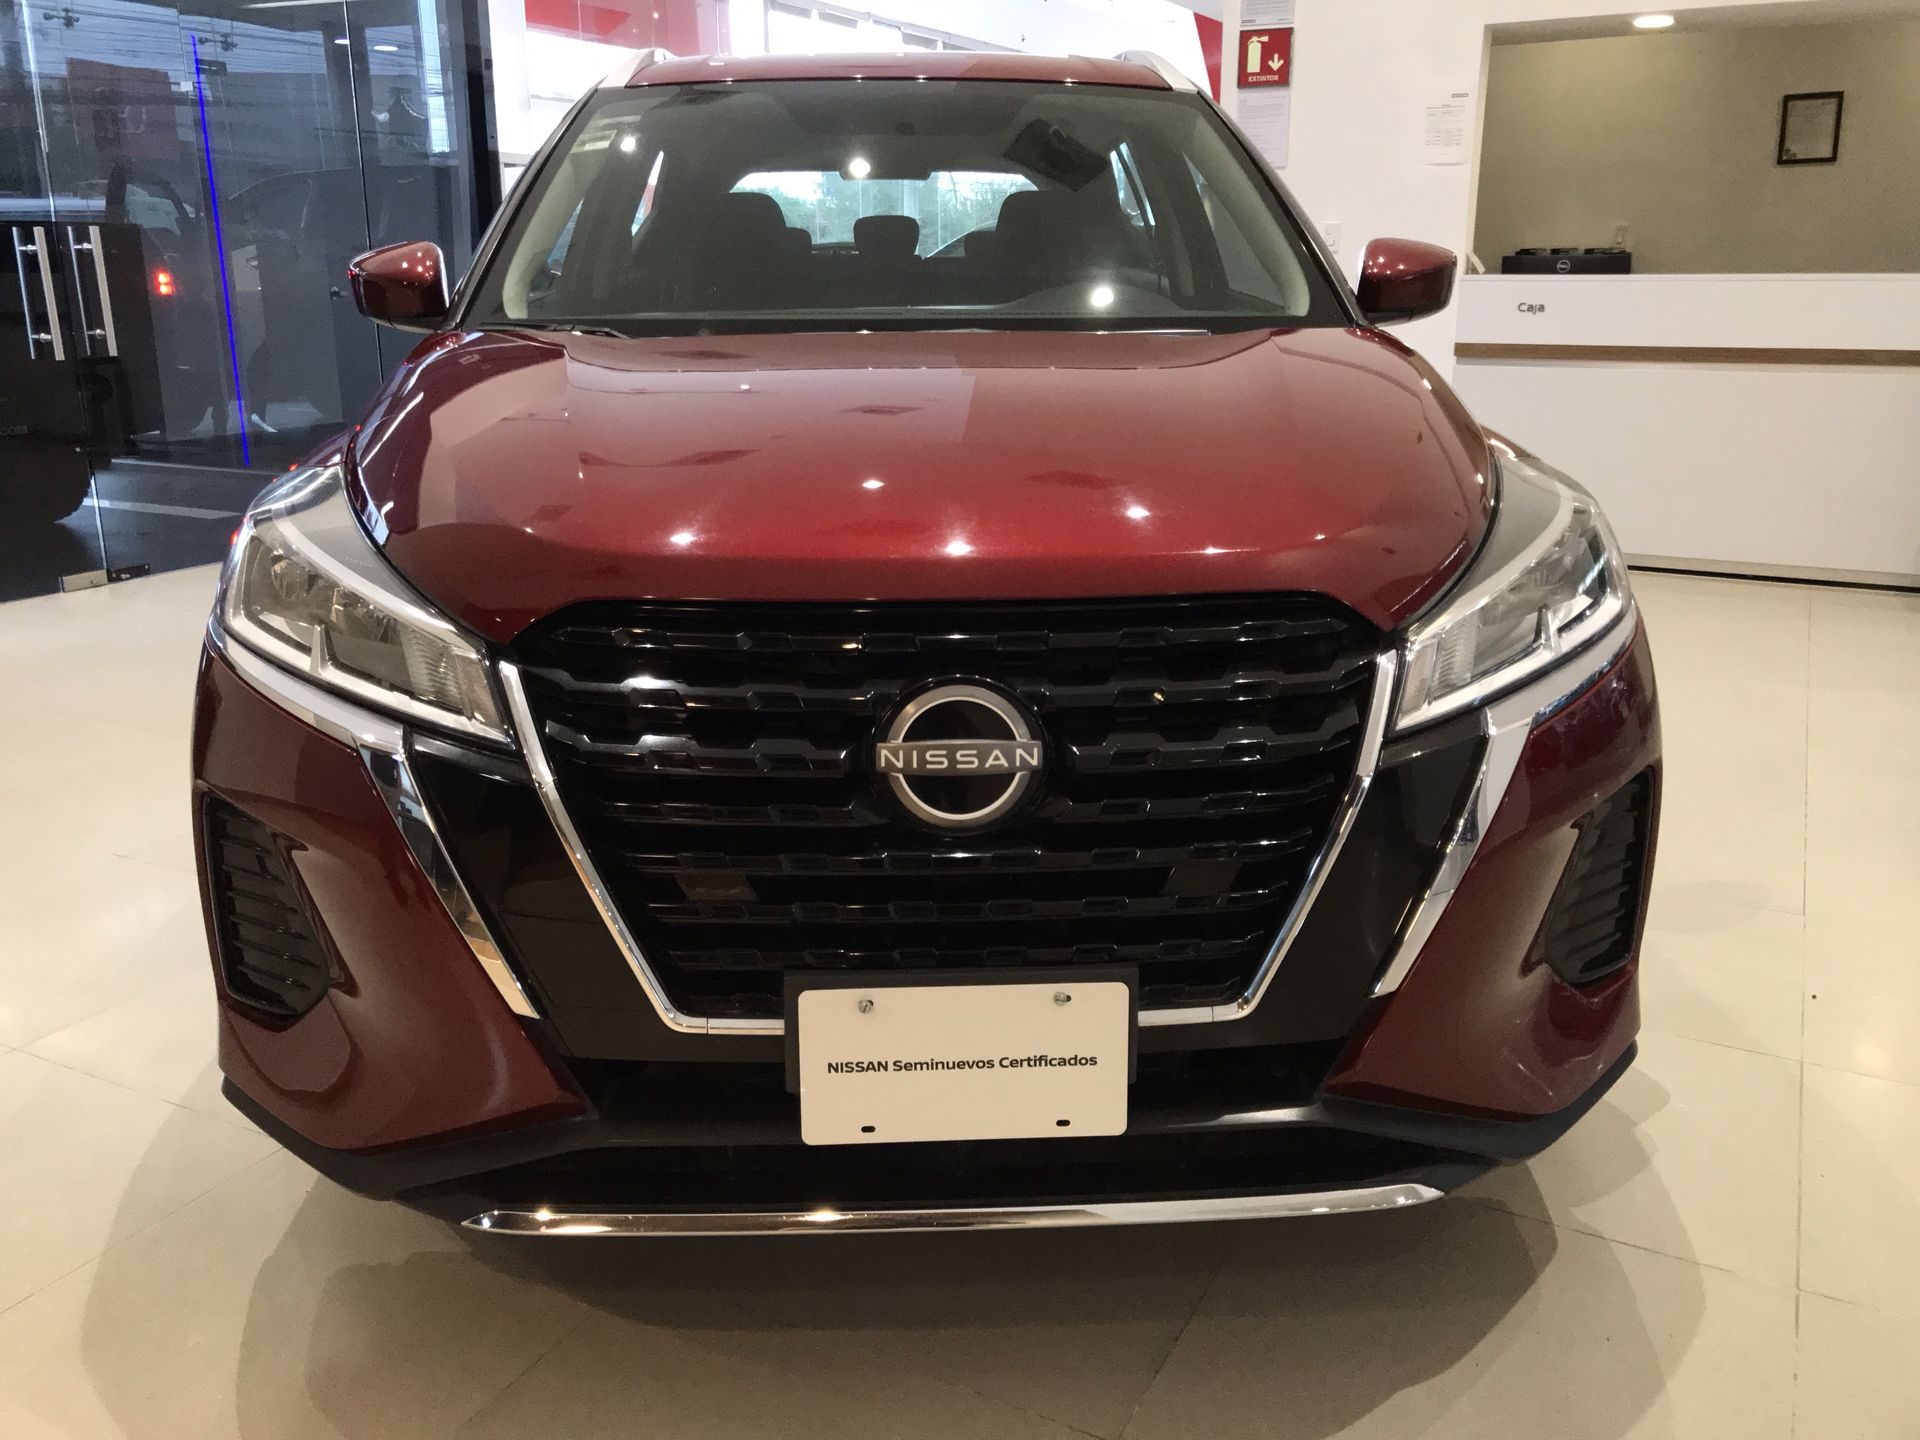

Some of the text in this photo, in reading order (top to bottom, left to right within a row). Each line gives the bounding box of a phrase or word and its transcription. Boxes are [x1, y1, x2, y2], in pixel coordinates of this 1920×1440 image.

[1517, 302, 1546, 314] Caja
[880, 747, 1039, 769] NISSAN
[827, 1054, 1098, 1073] NISSAN Seminuevos Certificados
